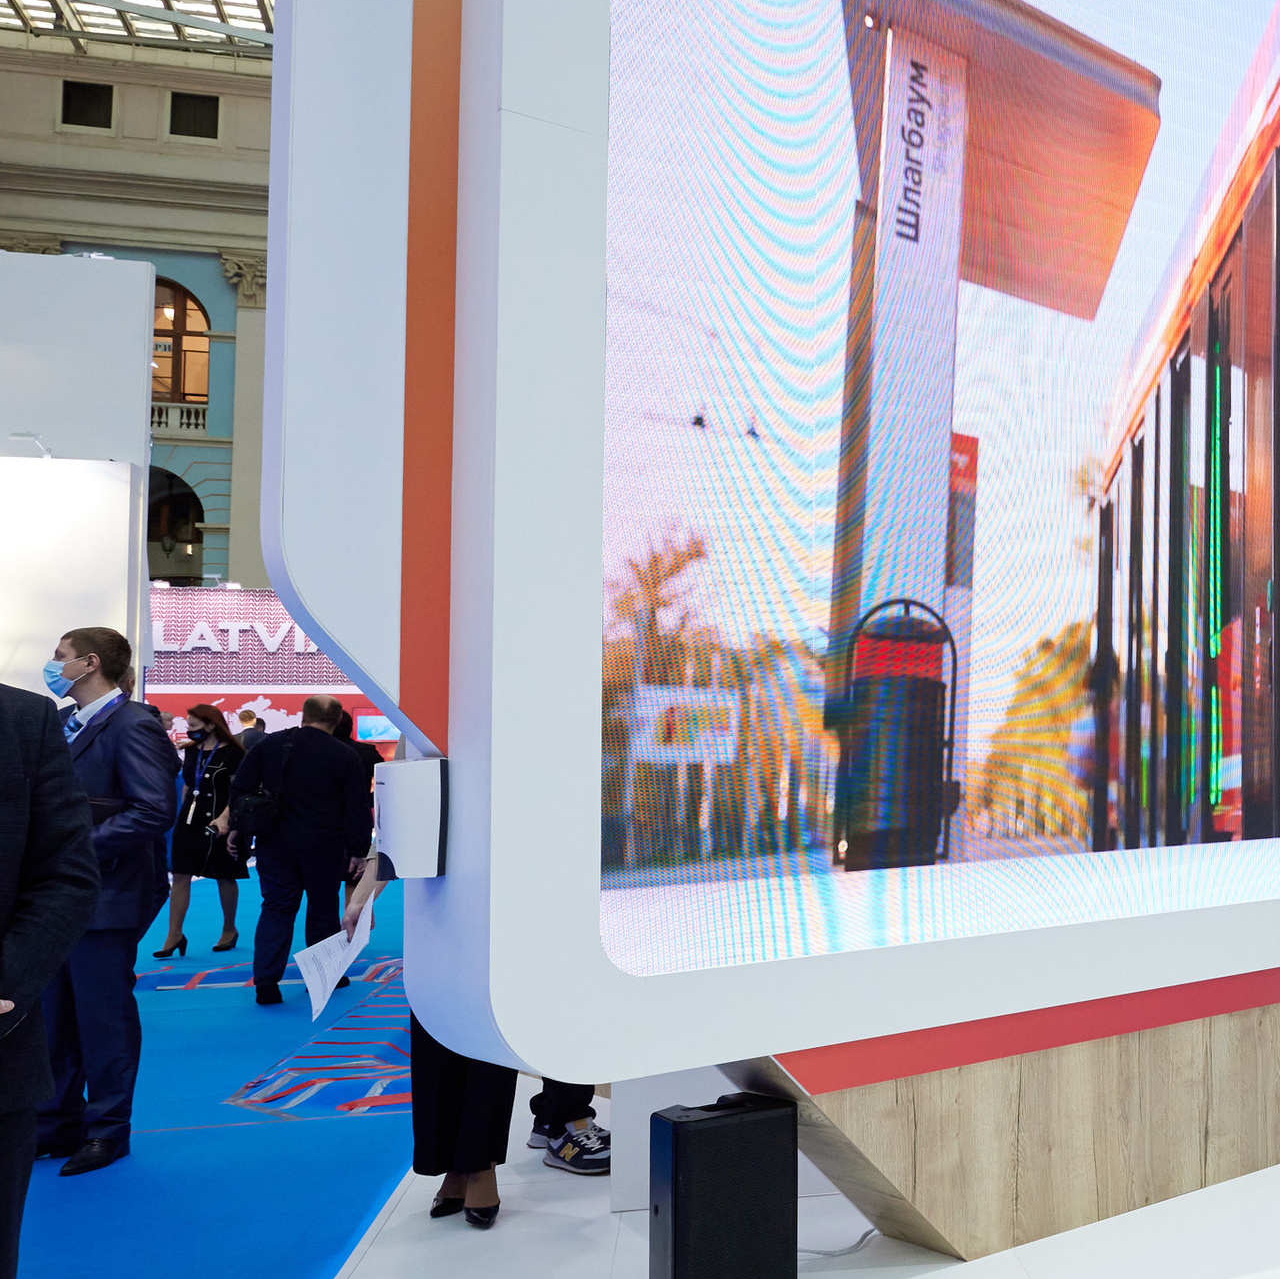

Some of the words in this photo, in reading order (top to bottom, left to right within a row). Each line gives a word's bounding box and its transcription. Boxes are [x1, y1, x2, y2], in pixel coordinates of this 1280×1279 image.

[896, 59, 932, 243] Шлагбаум
[152, 620, 319, 653] LATVI
[558, 1142, 580, 1162] N
